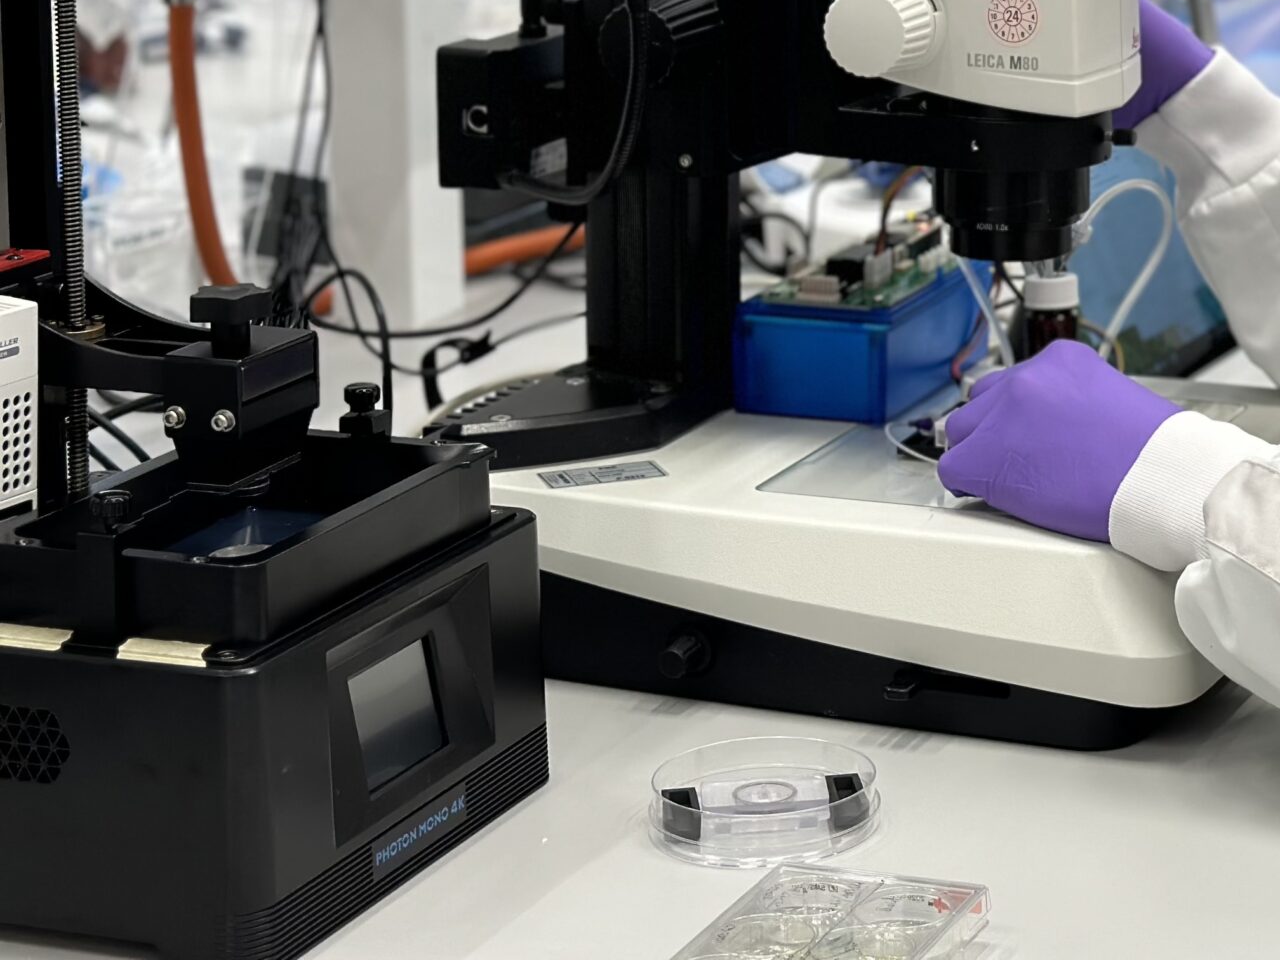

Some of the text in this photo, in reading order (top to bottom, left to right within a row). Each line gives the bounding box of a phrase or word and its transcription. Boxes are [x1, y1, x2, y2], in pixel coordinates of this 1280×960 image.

[1006, 9, 1020, 23] 24
[967, 52, 1039, 71] LEICA M80
[375, 795, 465, 866] PHOTON MONO 4K
